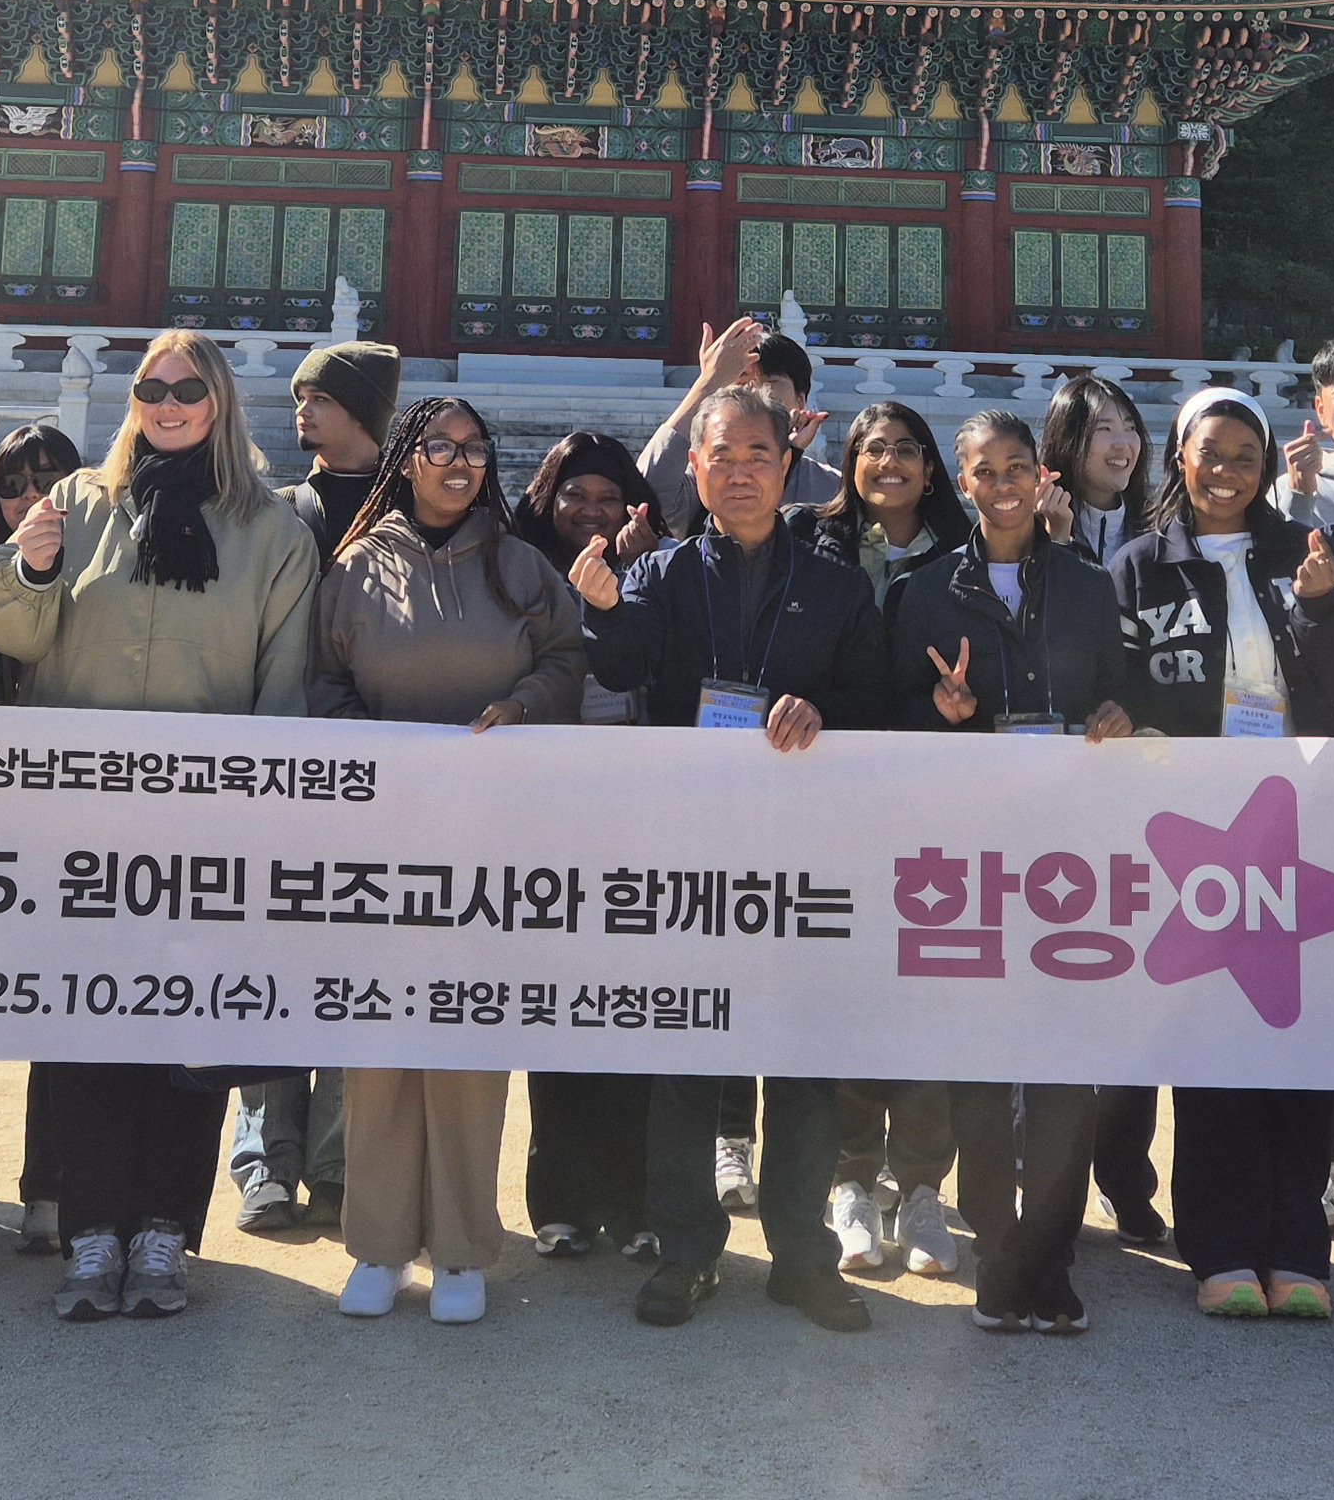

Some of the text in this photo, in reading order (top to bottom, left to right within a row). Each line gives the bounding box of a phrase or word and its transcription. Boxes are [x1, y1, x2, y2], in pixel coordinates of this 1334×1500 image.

[58, 850, 247, 923] 원어민
[267, 859, 587, 935] 보조교사와
[602, 868, 855, 940] 함께하는
[894, 847, 1151, 982] 함양
[1179, 865, 1298, 933] ON
[428, 980, 511, 1027] 함양
[521, 984, 558, 1029] 및
[569, 985, 732, 1033] 산청일대
